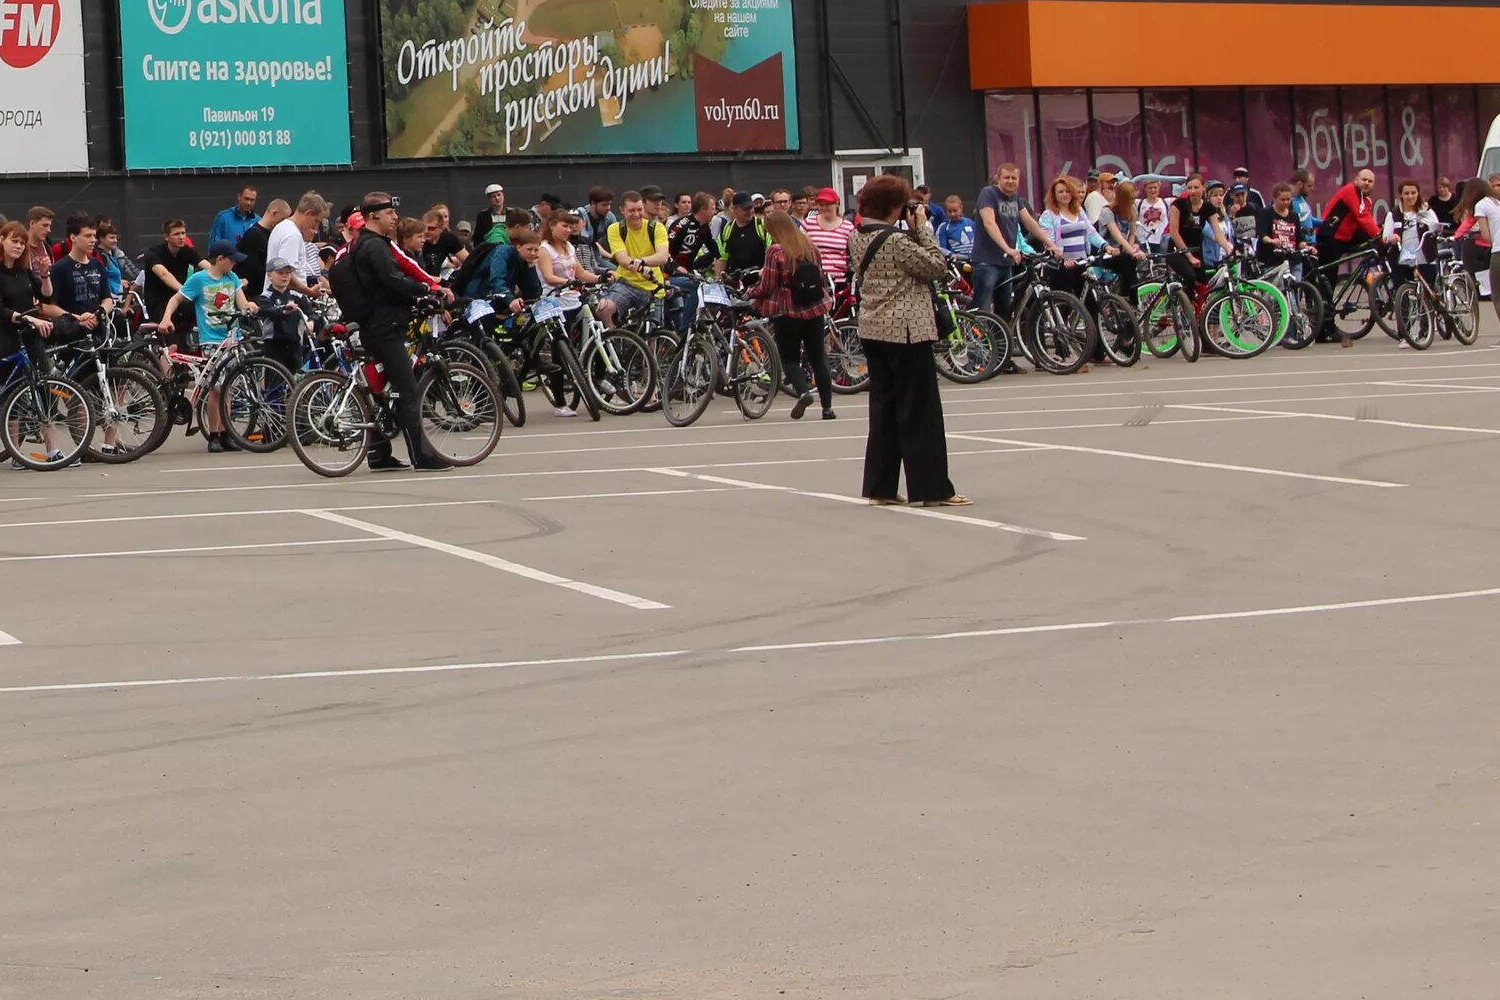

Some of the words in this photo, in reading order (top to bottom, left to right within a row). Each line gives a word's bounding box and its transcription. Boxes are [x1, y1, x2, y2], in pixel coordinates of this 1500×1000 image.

[713, 13, 724, 23] на
[727, 11, 757, 24] нашем
[723, 23, 749, 38] сайте
[397, 16, 527, 91] Откройте
[142, 54, 200, 81] Спите
[206, 60, 229, 80] на
[234, 55, 332, 87] здоровье!
[479, 33, 600, 112] просторы
[504, 64, 597, 153] русской
[600, 39, 671, 119] души!
[203, 107, 258, 122] Павильон
[261, 106, 275, 122] 19
[704, 98, 780, 128] volyn60.ru
[189, 131, 197, 147] 8
[200, 130, 232, 149] (921)
[235, 130, 256, 146] 000
[259, 130, 272, 146] 81
[276, 130, 291, 145] 88
